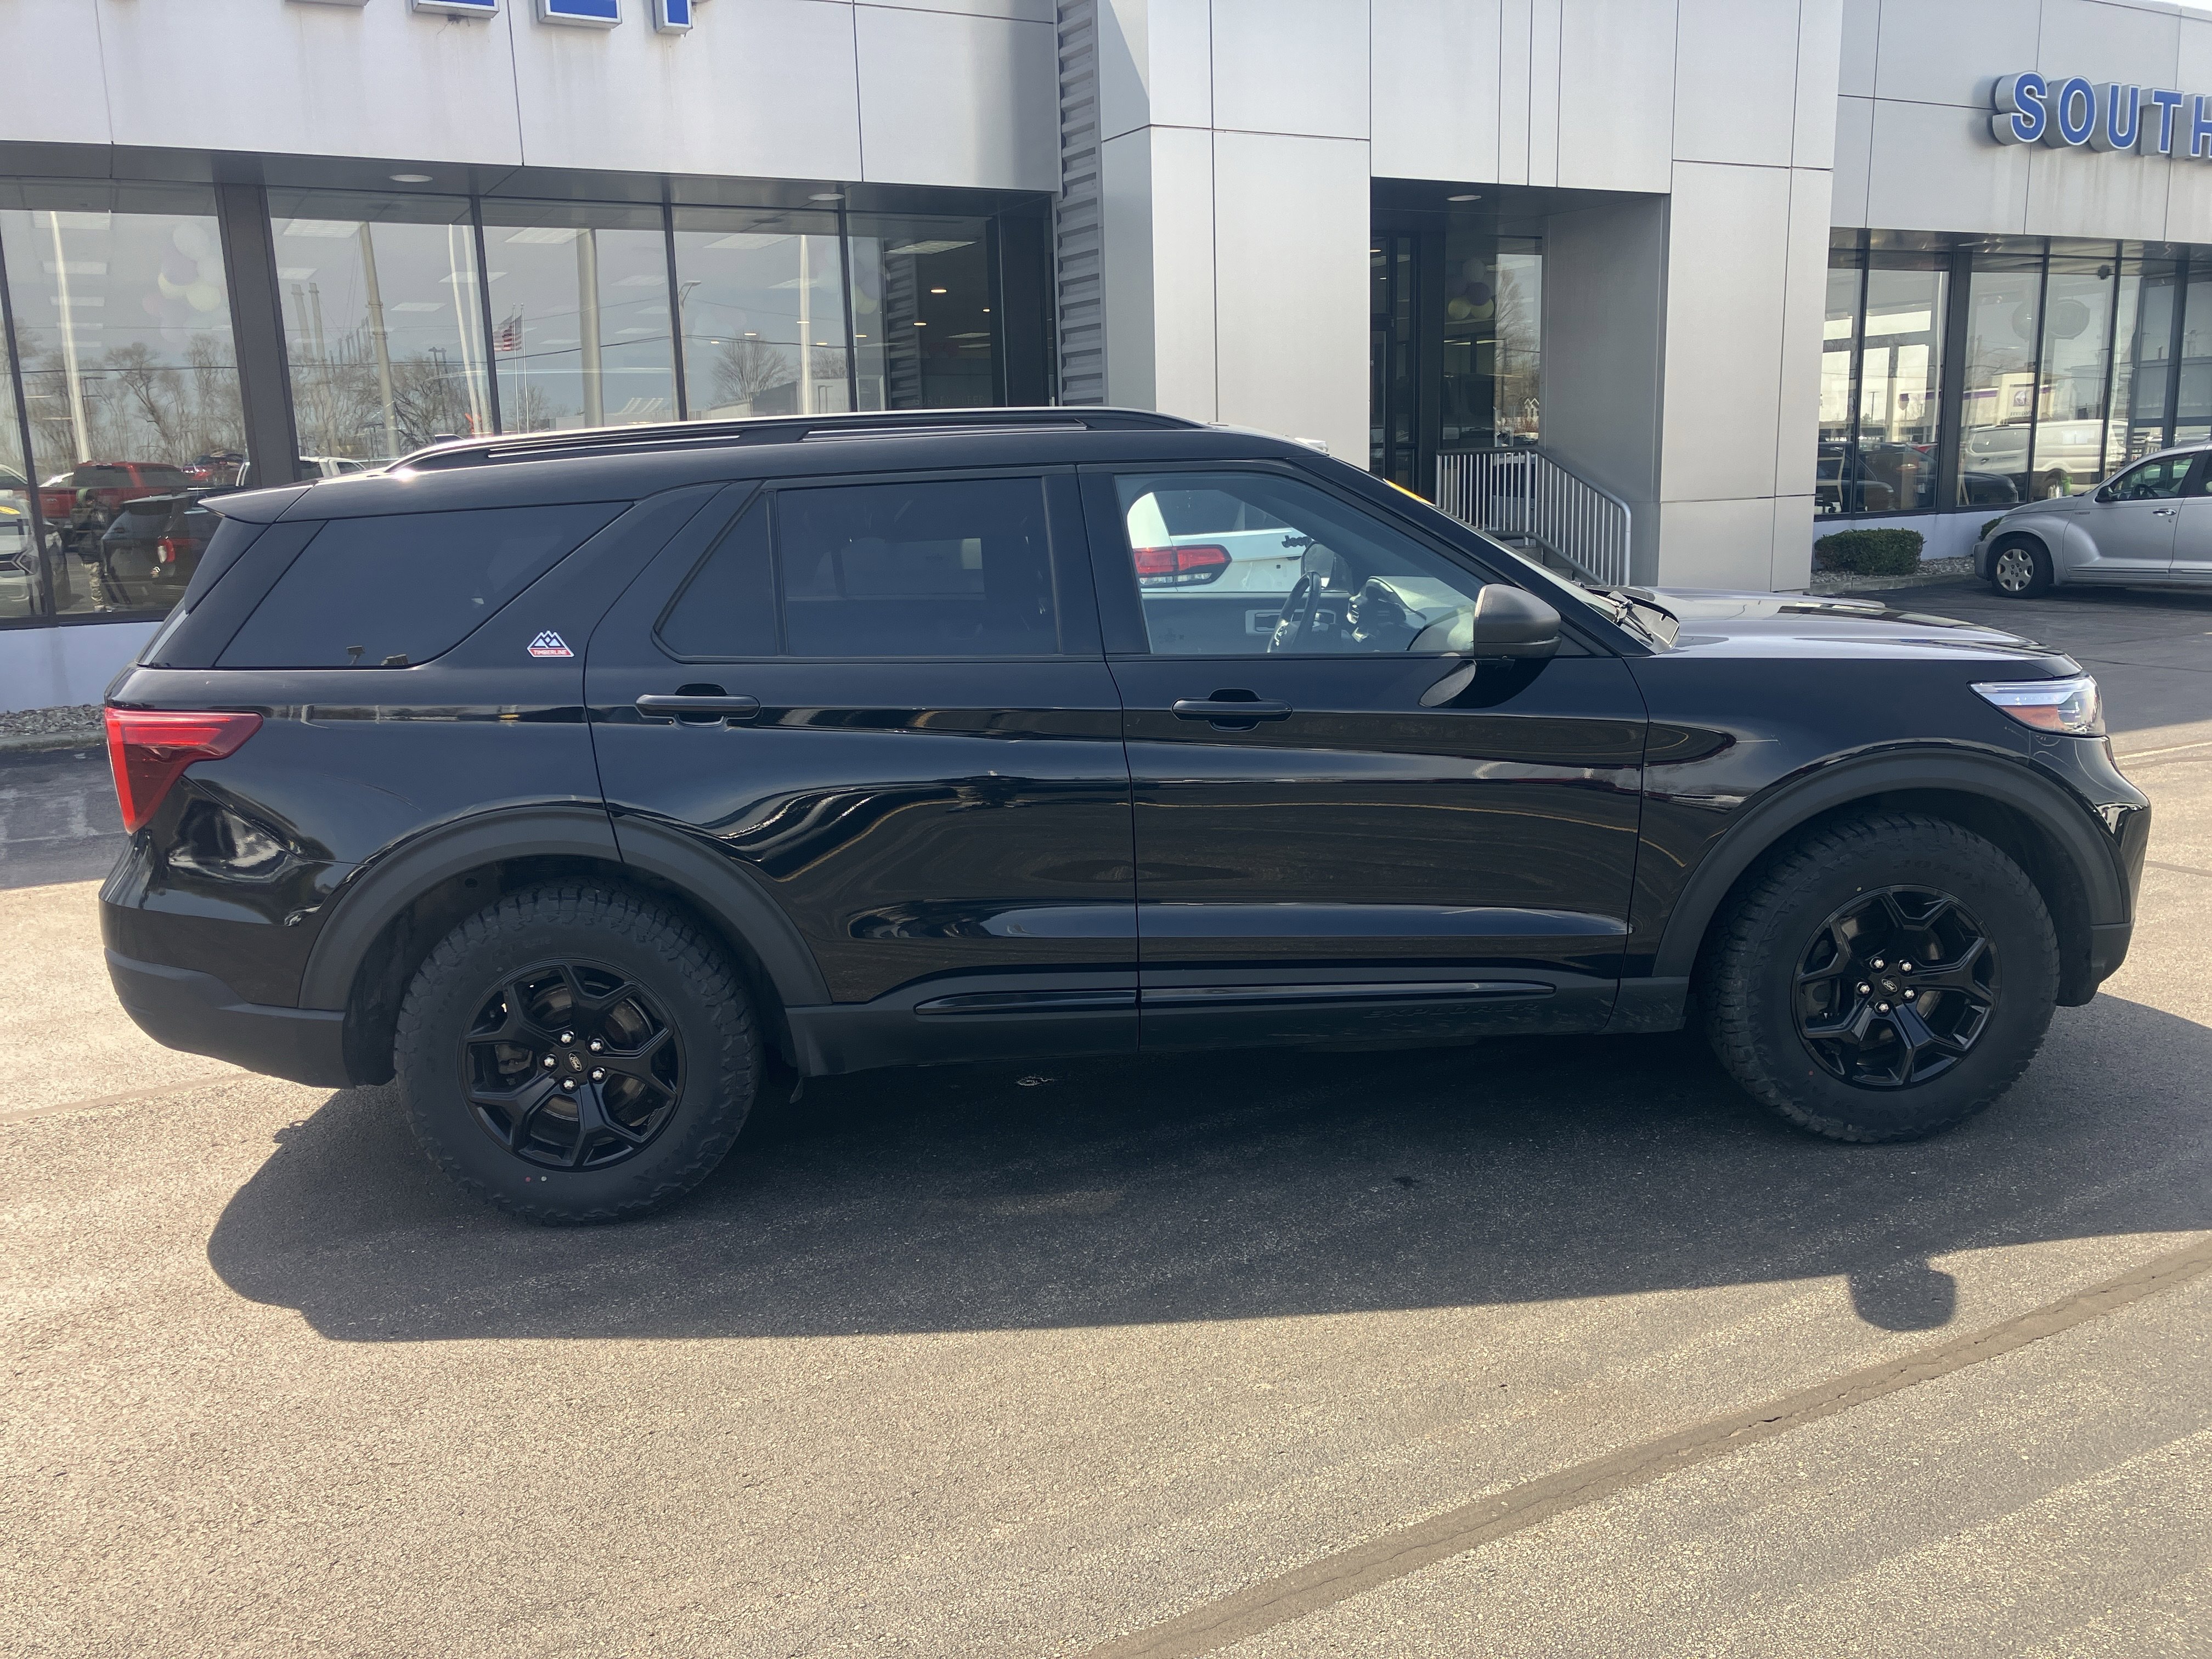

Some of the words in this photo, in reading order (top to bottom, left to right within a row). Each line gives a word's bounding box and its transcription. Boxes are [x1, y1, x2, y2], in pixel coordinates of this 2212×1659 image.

[1883, 980, 1897, 991] Ford
[1363, 1003, 1538, 1019] EXPLORER
[569, 1055, 581, 1069] Ford
